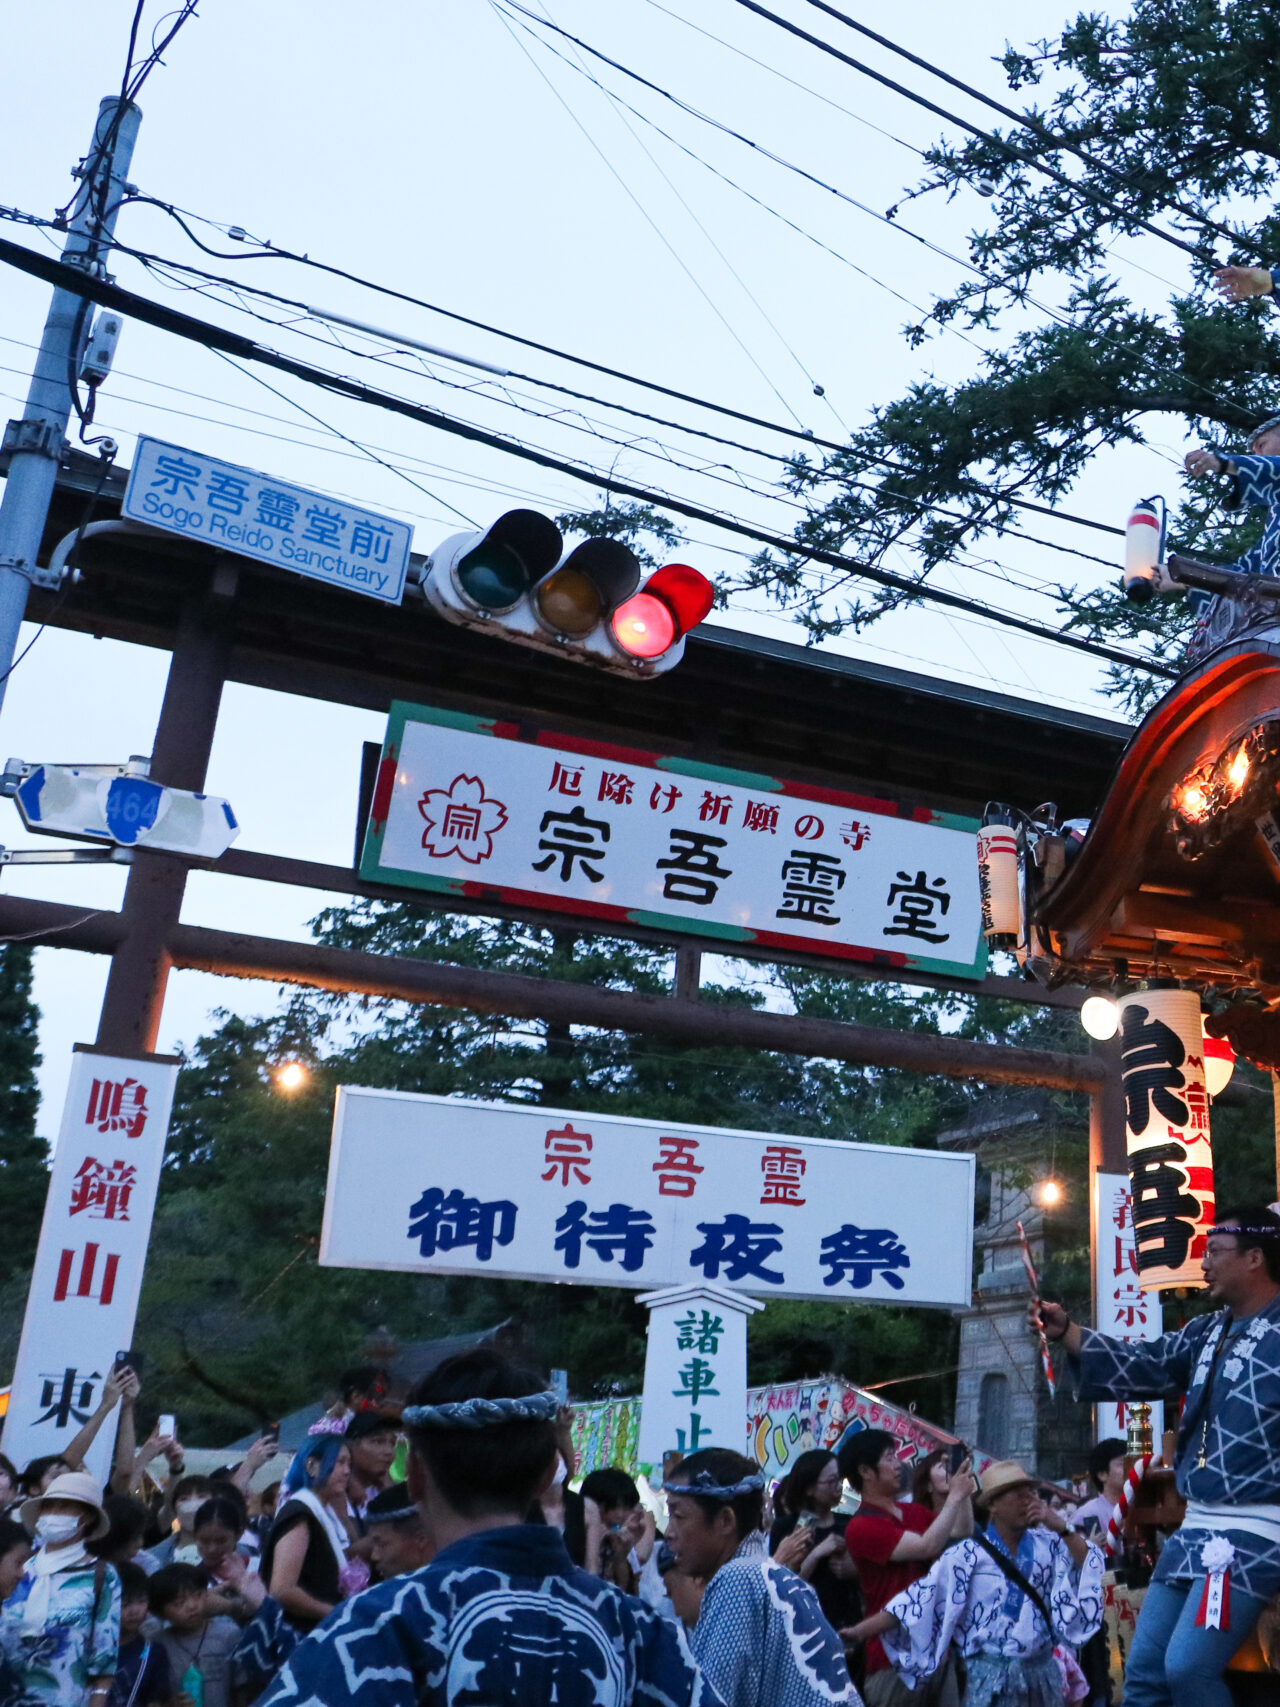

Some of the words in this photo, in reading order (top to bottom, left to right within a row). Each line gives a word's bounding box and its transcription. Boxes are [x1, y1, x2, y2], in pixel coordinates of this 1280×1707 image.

[142, 493, 203, 529] Sogo
[209, 513, 274, 552] Reido
[278, 538, 390, 592] Sanctuary
[150, 455, 394, 564] 宗吾霊堂前
[107, 791, 158, 823] 464
[547, 760, 872, 852] 厄除け祈願の寺
[531, 805, 951, 945] 宗吾霊堂
[53, 1076, 149, 1307] 鳴鐘山
[541, 1122, 807, 1207] 宗吾霊
[406, 1186, 911, 1291] 御待夜祭
[31, 1367, 104, 1429] 東
